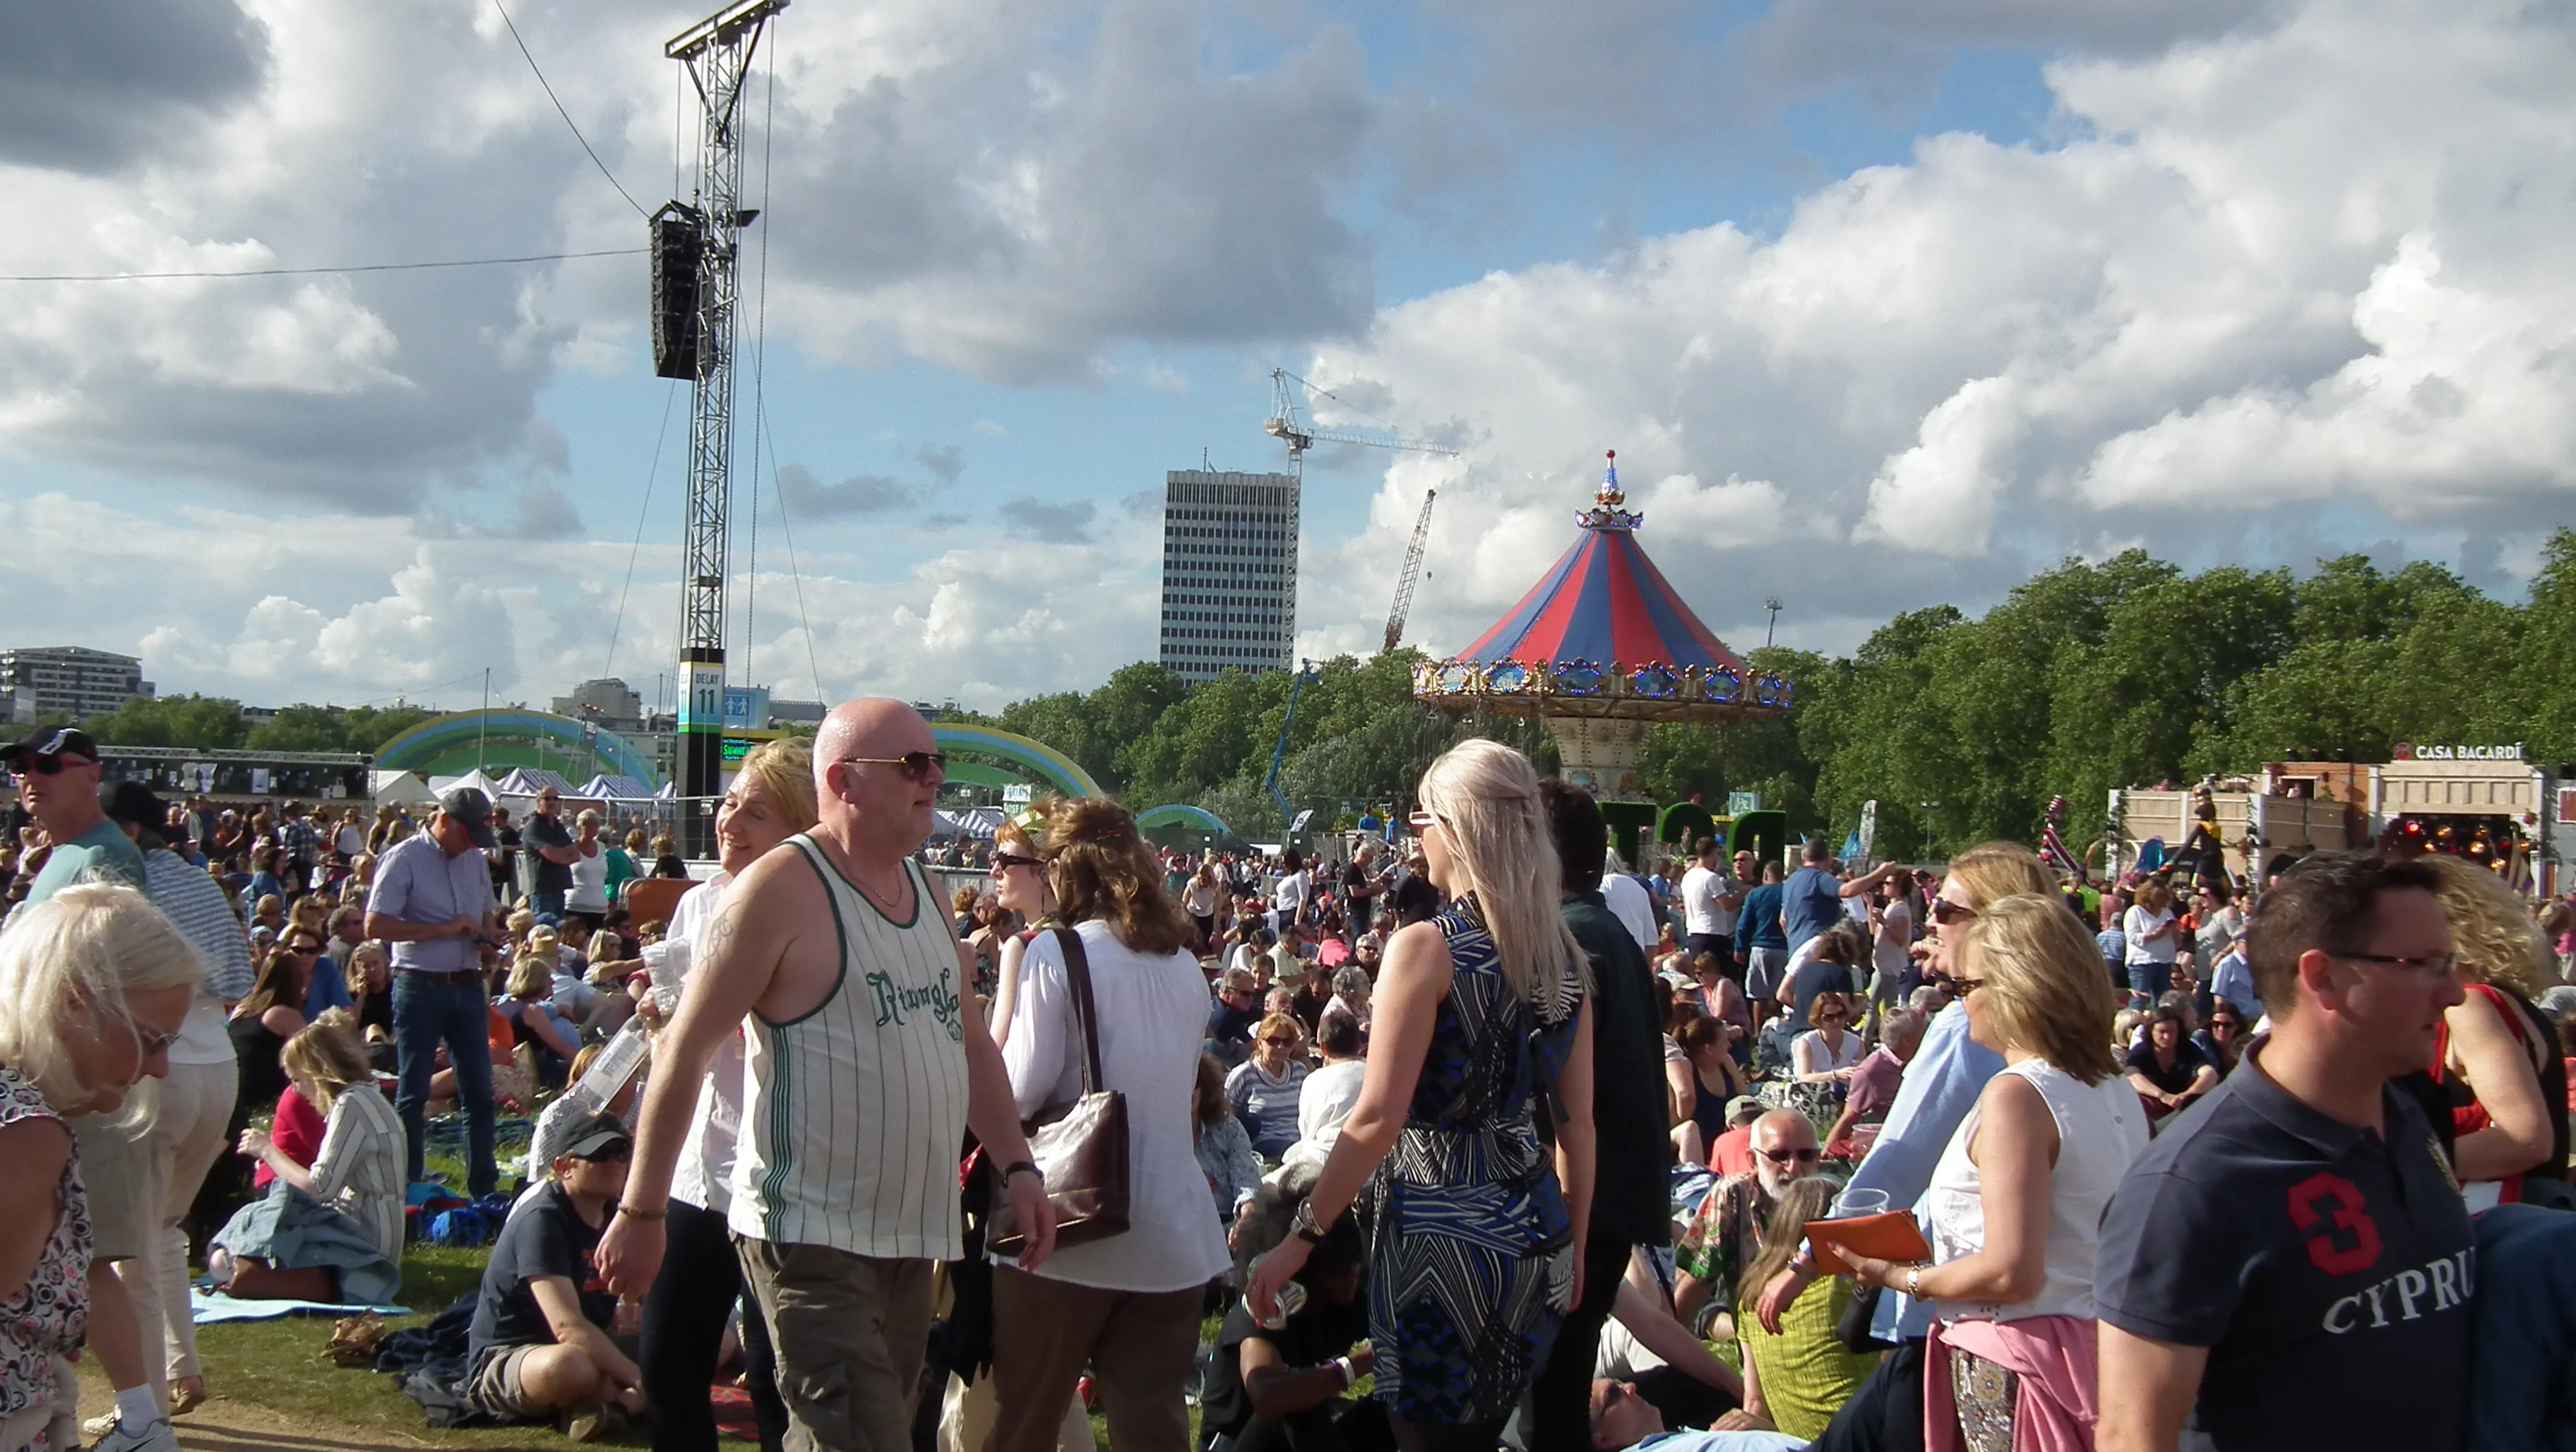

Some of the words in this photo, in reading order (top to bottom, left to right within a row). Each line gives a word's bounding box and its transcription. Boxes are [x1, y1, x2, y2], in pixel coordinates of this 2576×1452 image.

[696, 673, 720, 684] DELAY
[699, 689, 715, 714] 11
[2415, 745, 2454, 759] CASA
[2286, 1171, 2384, 1277] 3
